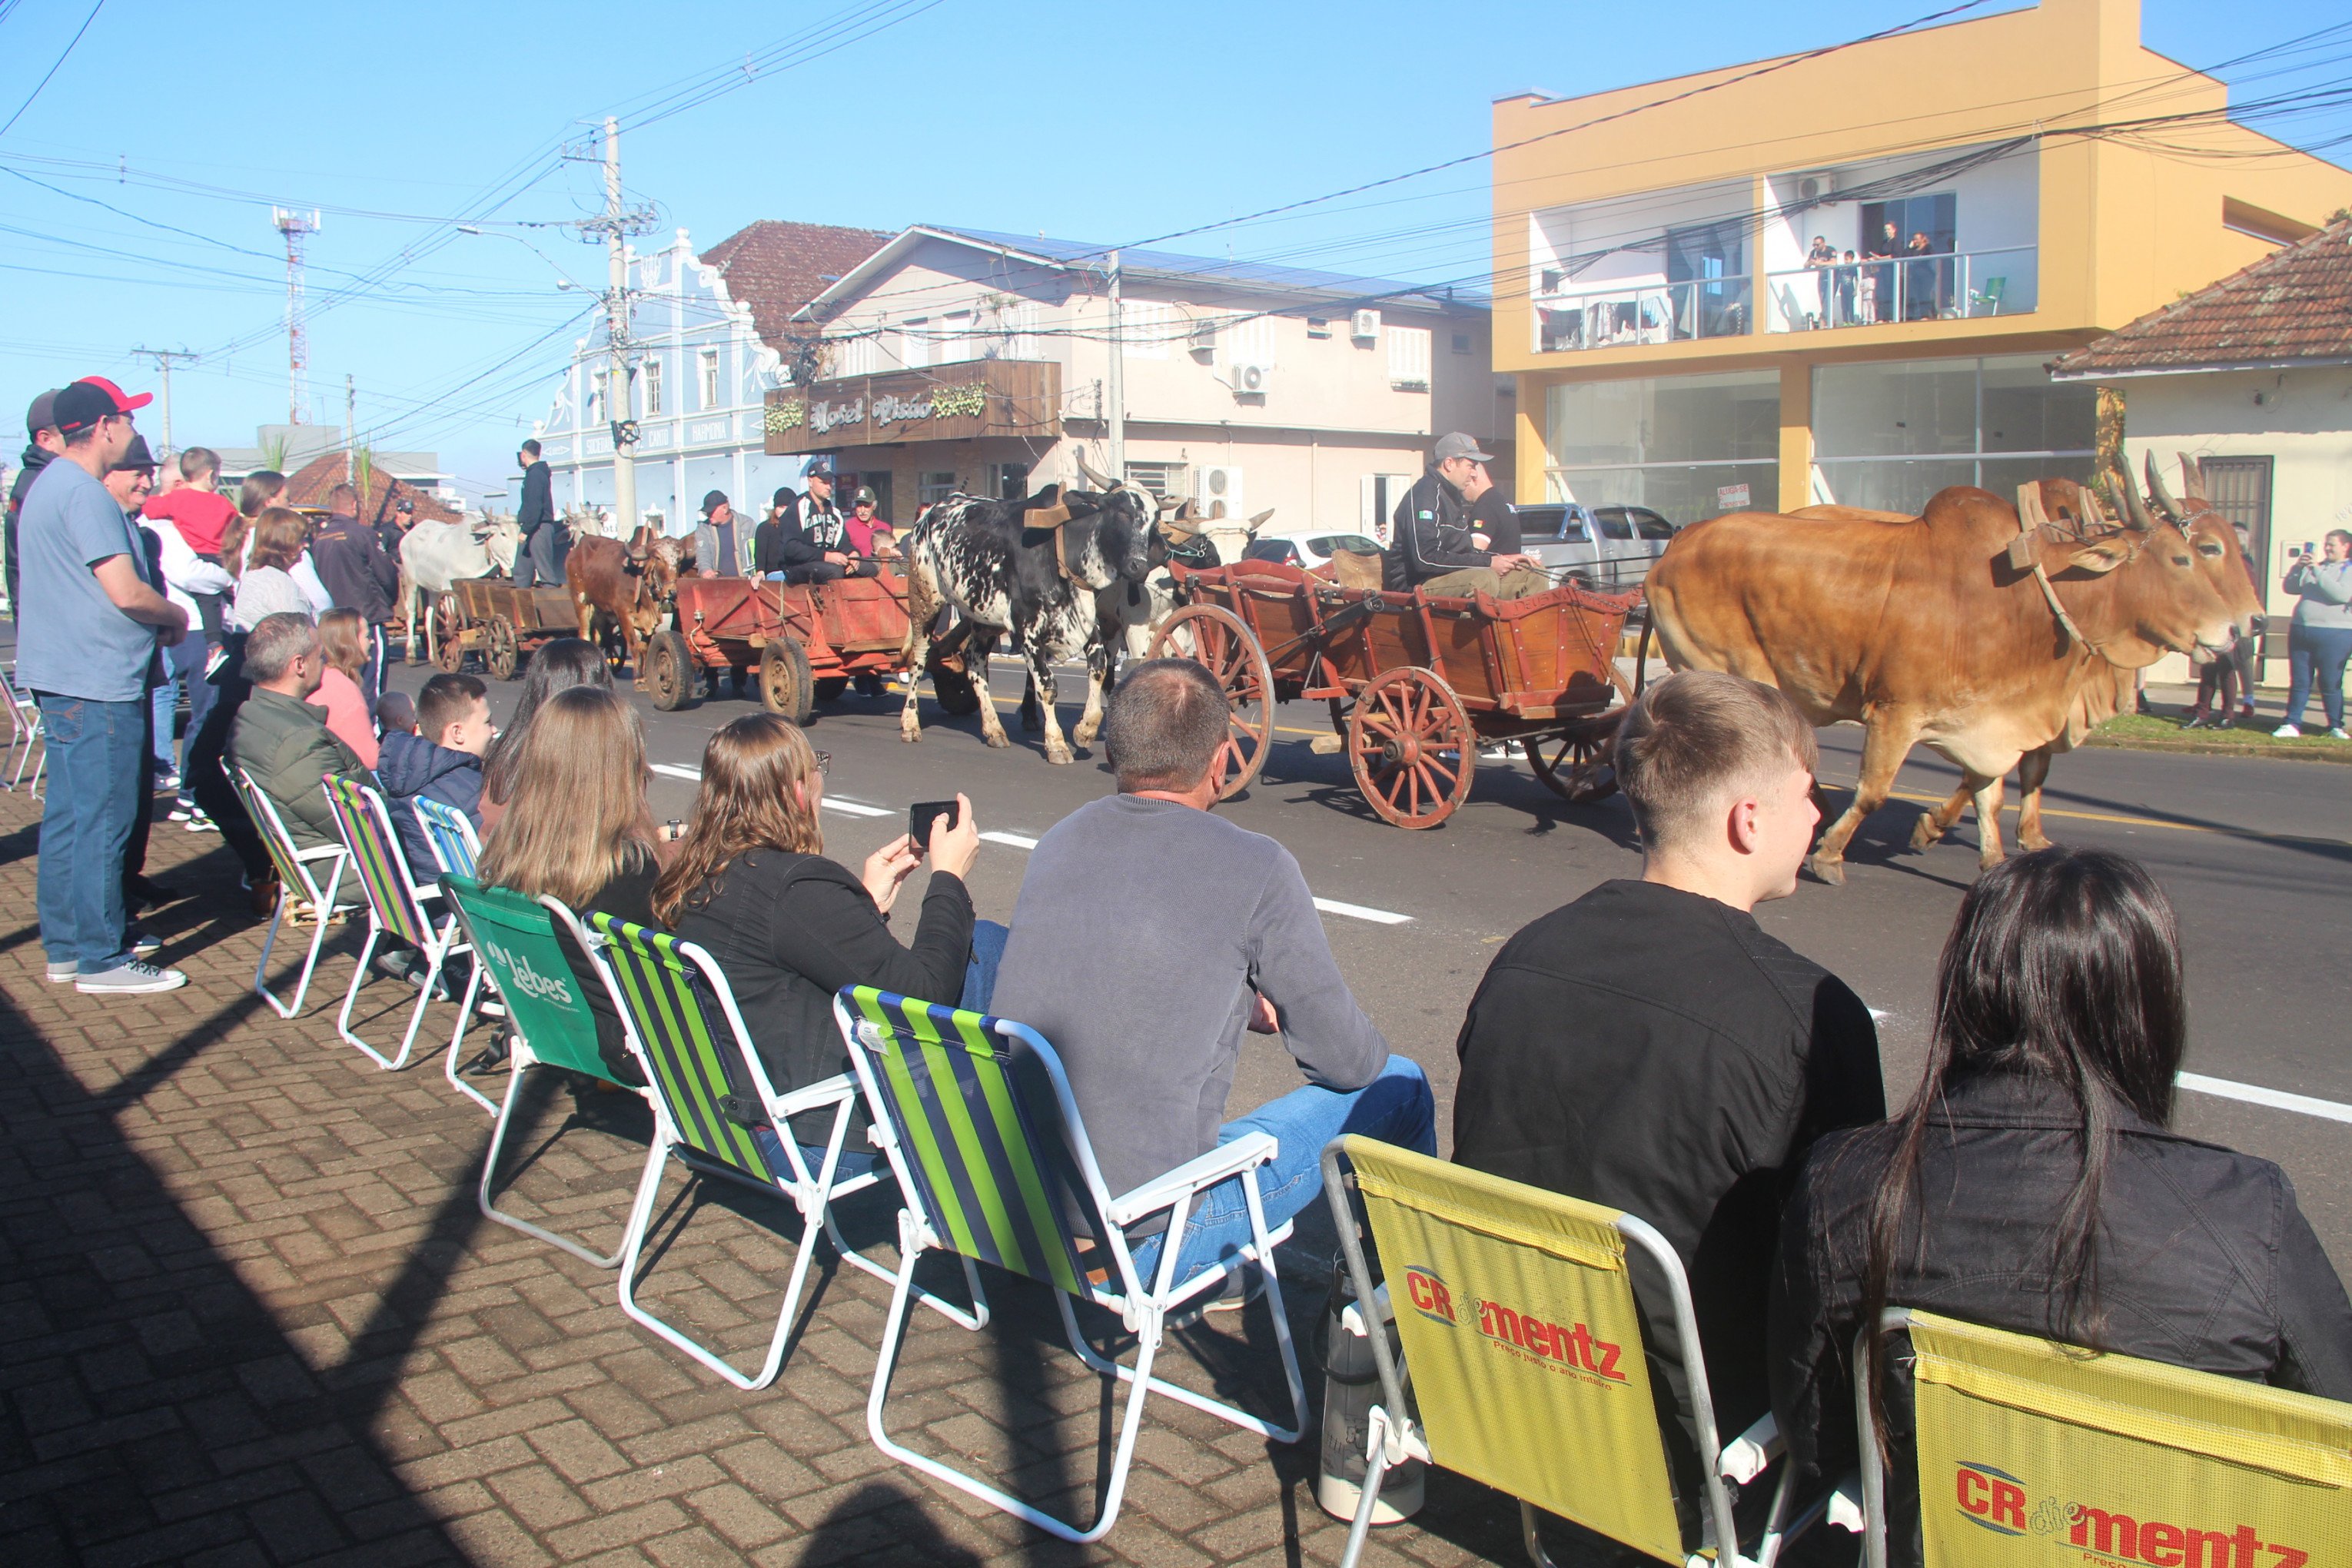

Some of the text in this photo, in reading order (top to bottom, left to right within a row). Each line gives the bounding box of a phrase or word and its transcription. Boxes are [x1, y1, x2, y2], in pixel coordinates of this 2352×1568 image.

[649, 429, 669, 447] CANTO
[693, 421, 726, 443] HARMONIA
[809, 397, 865, 434] Hotel
[1719, 484, 1748, 495] ALUGA-SE
[504, 948, 573, 1004] Lebes
[1406, 1271, 1457, 1322] CR
[1493, 1340, 1521, 1358] Preço
[1523, 1353, 1546, 1369] justo
[1549, 1364, 1556, 1373] o
[1559, 1366, 1577, 1380] ano
[1956, 1469, 2027, 1530] CR
